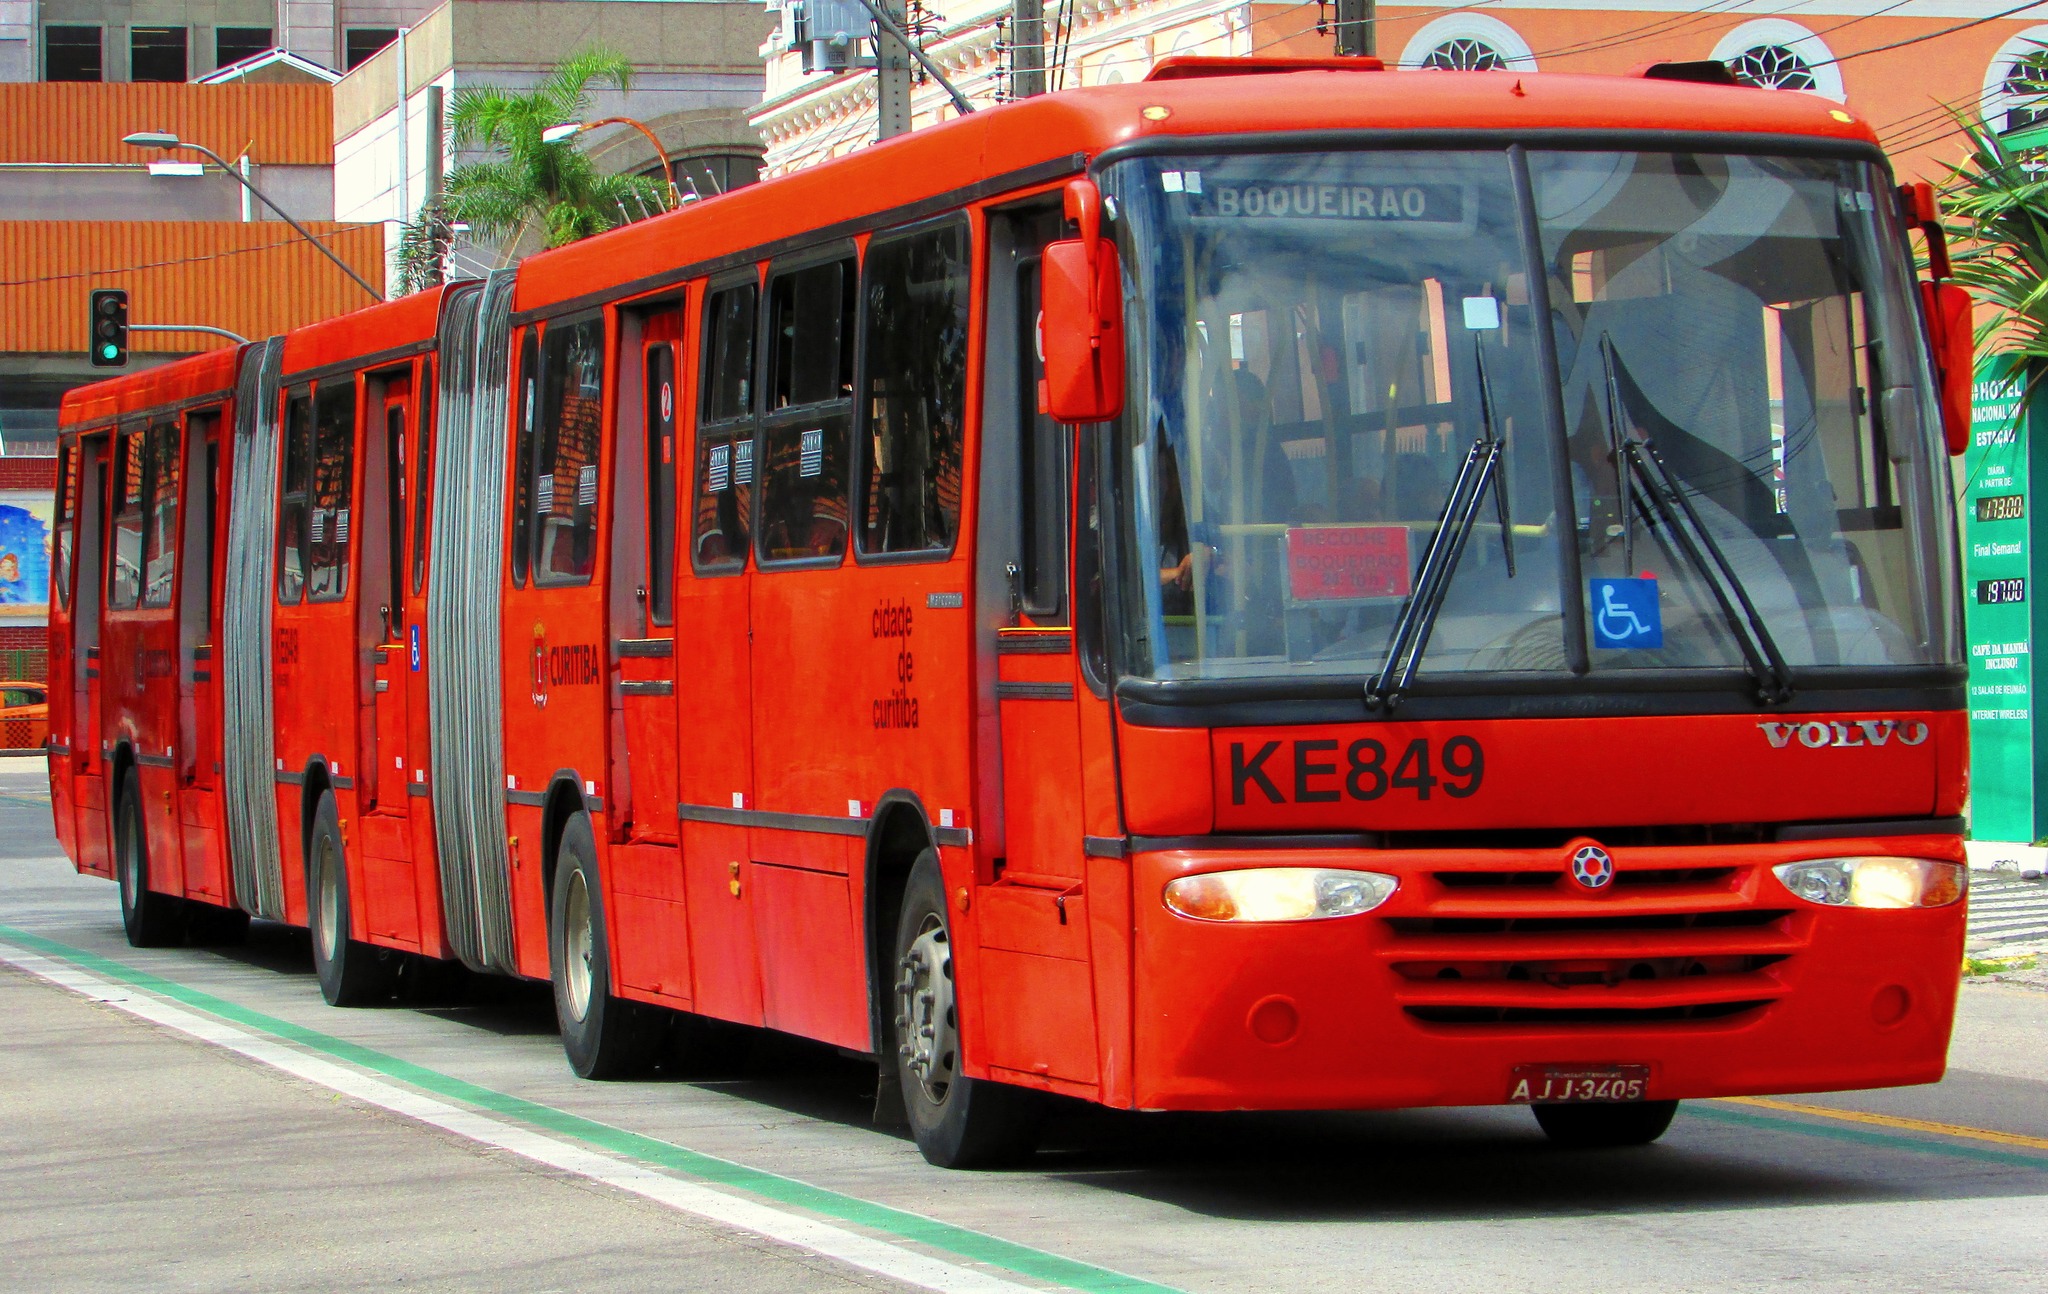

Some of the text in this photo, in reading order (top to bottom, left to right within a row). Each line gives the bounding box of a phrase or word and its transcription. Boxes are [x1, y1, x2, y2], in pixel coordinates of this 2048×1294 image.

[1217, 186, 1425, 217] BOQUEIRAO
[664, 384, 670, 416] 2
[1980, 379, 2022, 401] HOTEL
[1972, 404, 2006, 423] NACIONAL
[1974, 544, 1991, 557] Final
[872, 597, 913, 639] cidade
[1972, 641, 1991, 656] CAFÉ
[1992, 644, 2001, 655] DA
[550, 644, 600, 687] CURITIBA
[897, 646, 913, 683] de
[1985, 658, 2018, 670] INCLUSO!
[1978, 686, 1994, 695] SALAS
[1995, 685, 2003, 694] DE
[872, 686, 919, 729] curitiba
[1972, 709, 2028, 720] INTERNET WIRELESS
[1756, 719, 1929, 748] VOLVO
[1230, 735, 1485, 805] KE849
